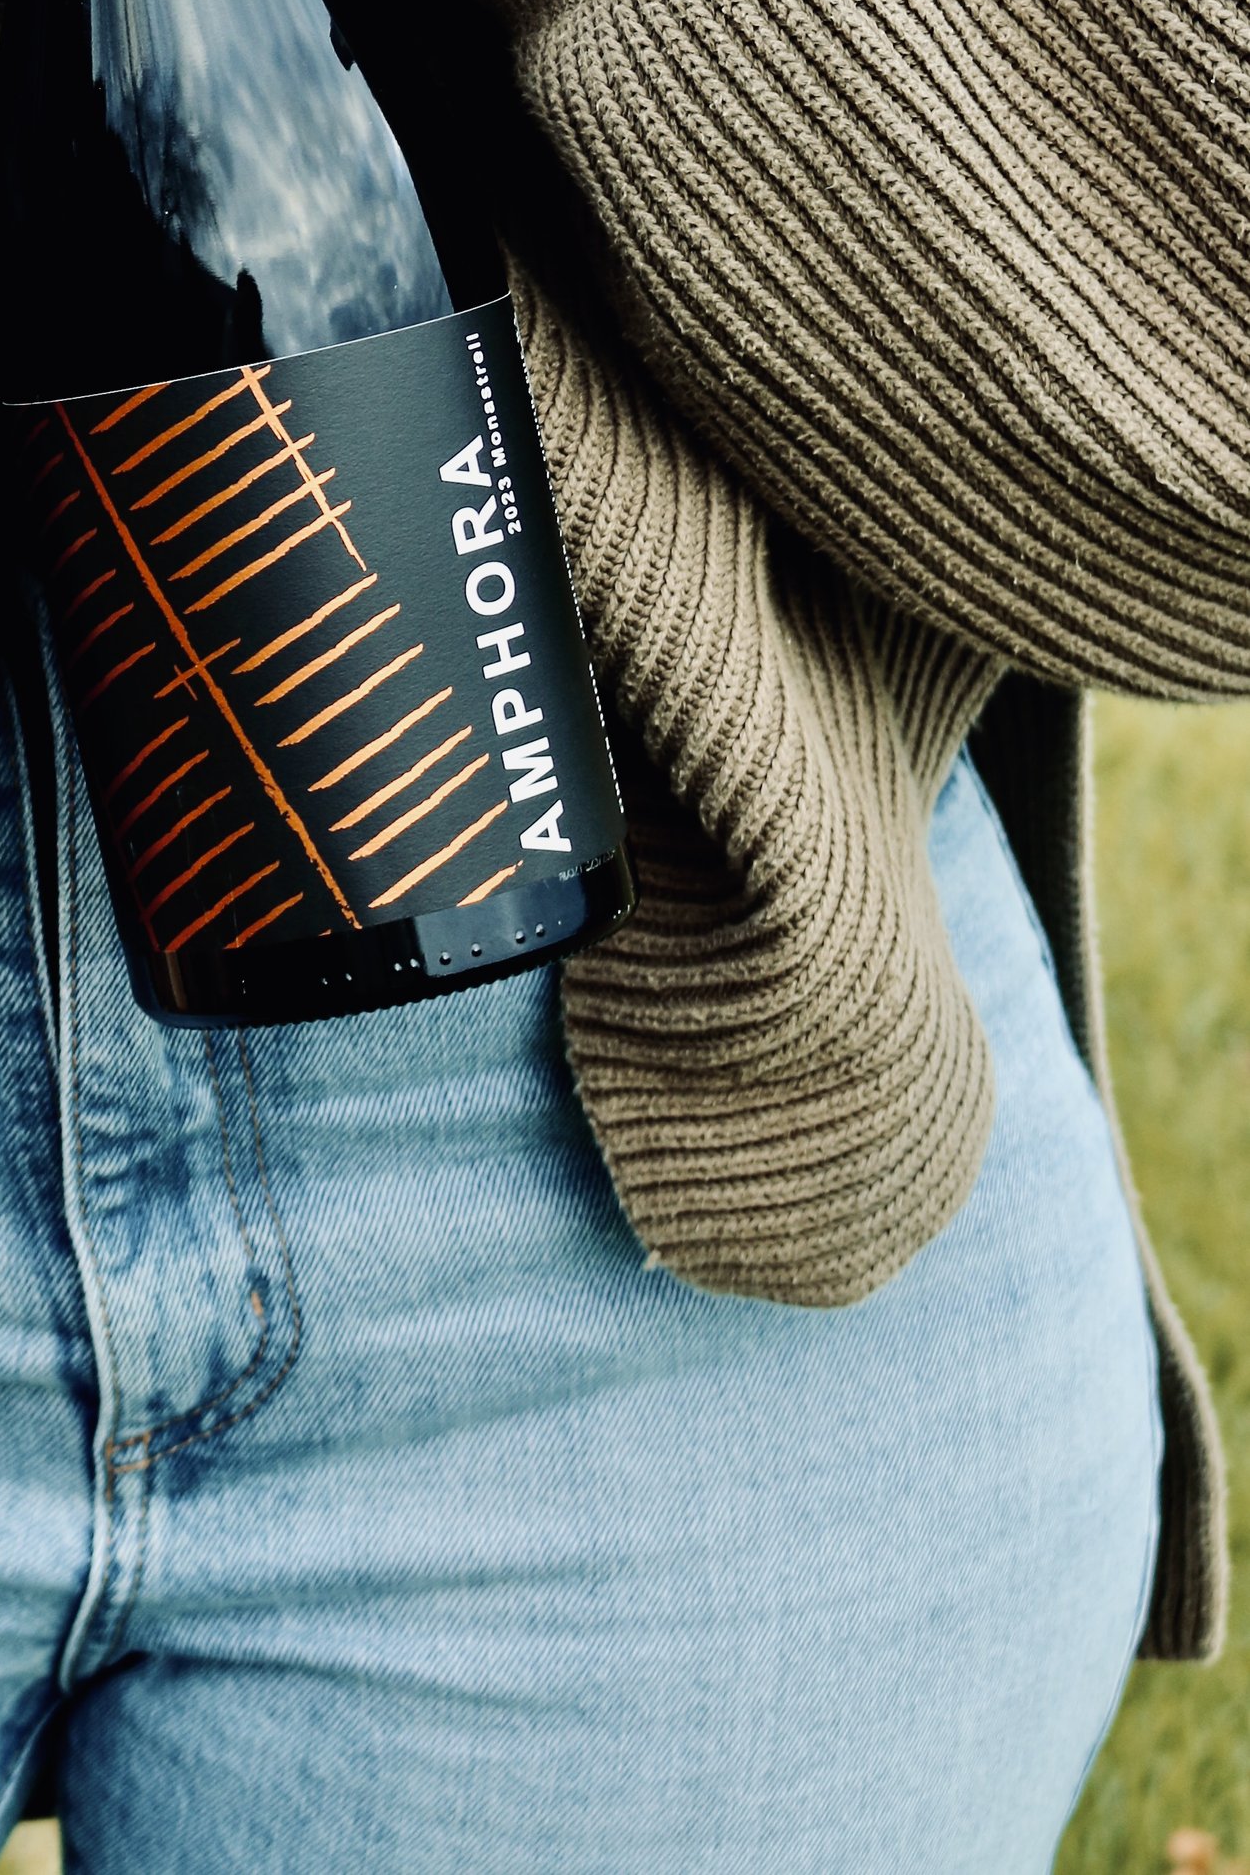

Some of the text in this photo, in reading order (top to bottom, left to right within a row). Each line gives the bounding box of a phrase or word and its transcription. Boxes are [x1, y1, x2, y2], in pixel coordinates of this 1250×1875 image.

[465, 331, 522, 536] 2023 Monastrell
[439, 434, 573, 853] AMPHORA
